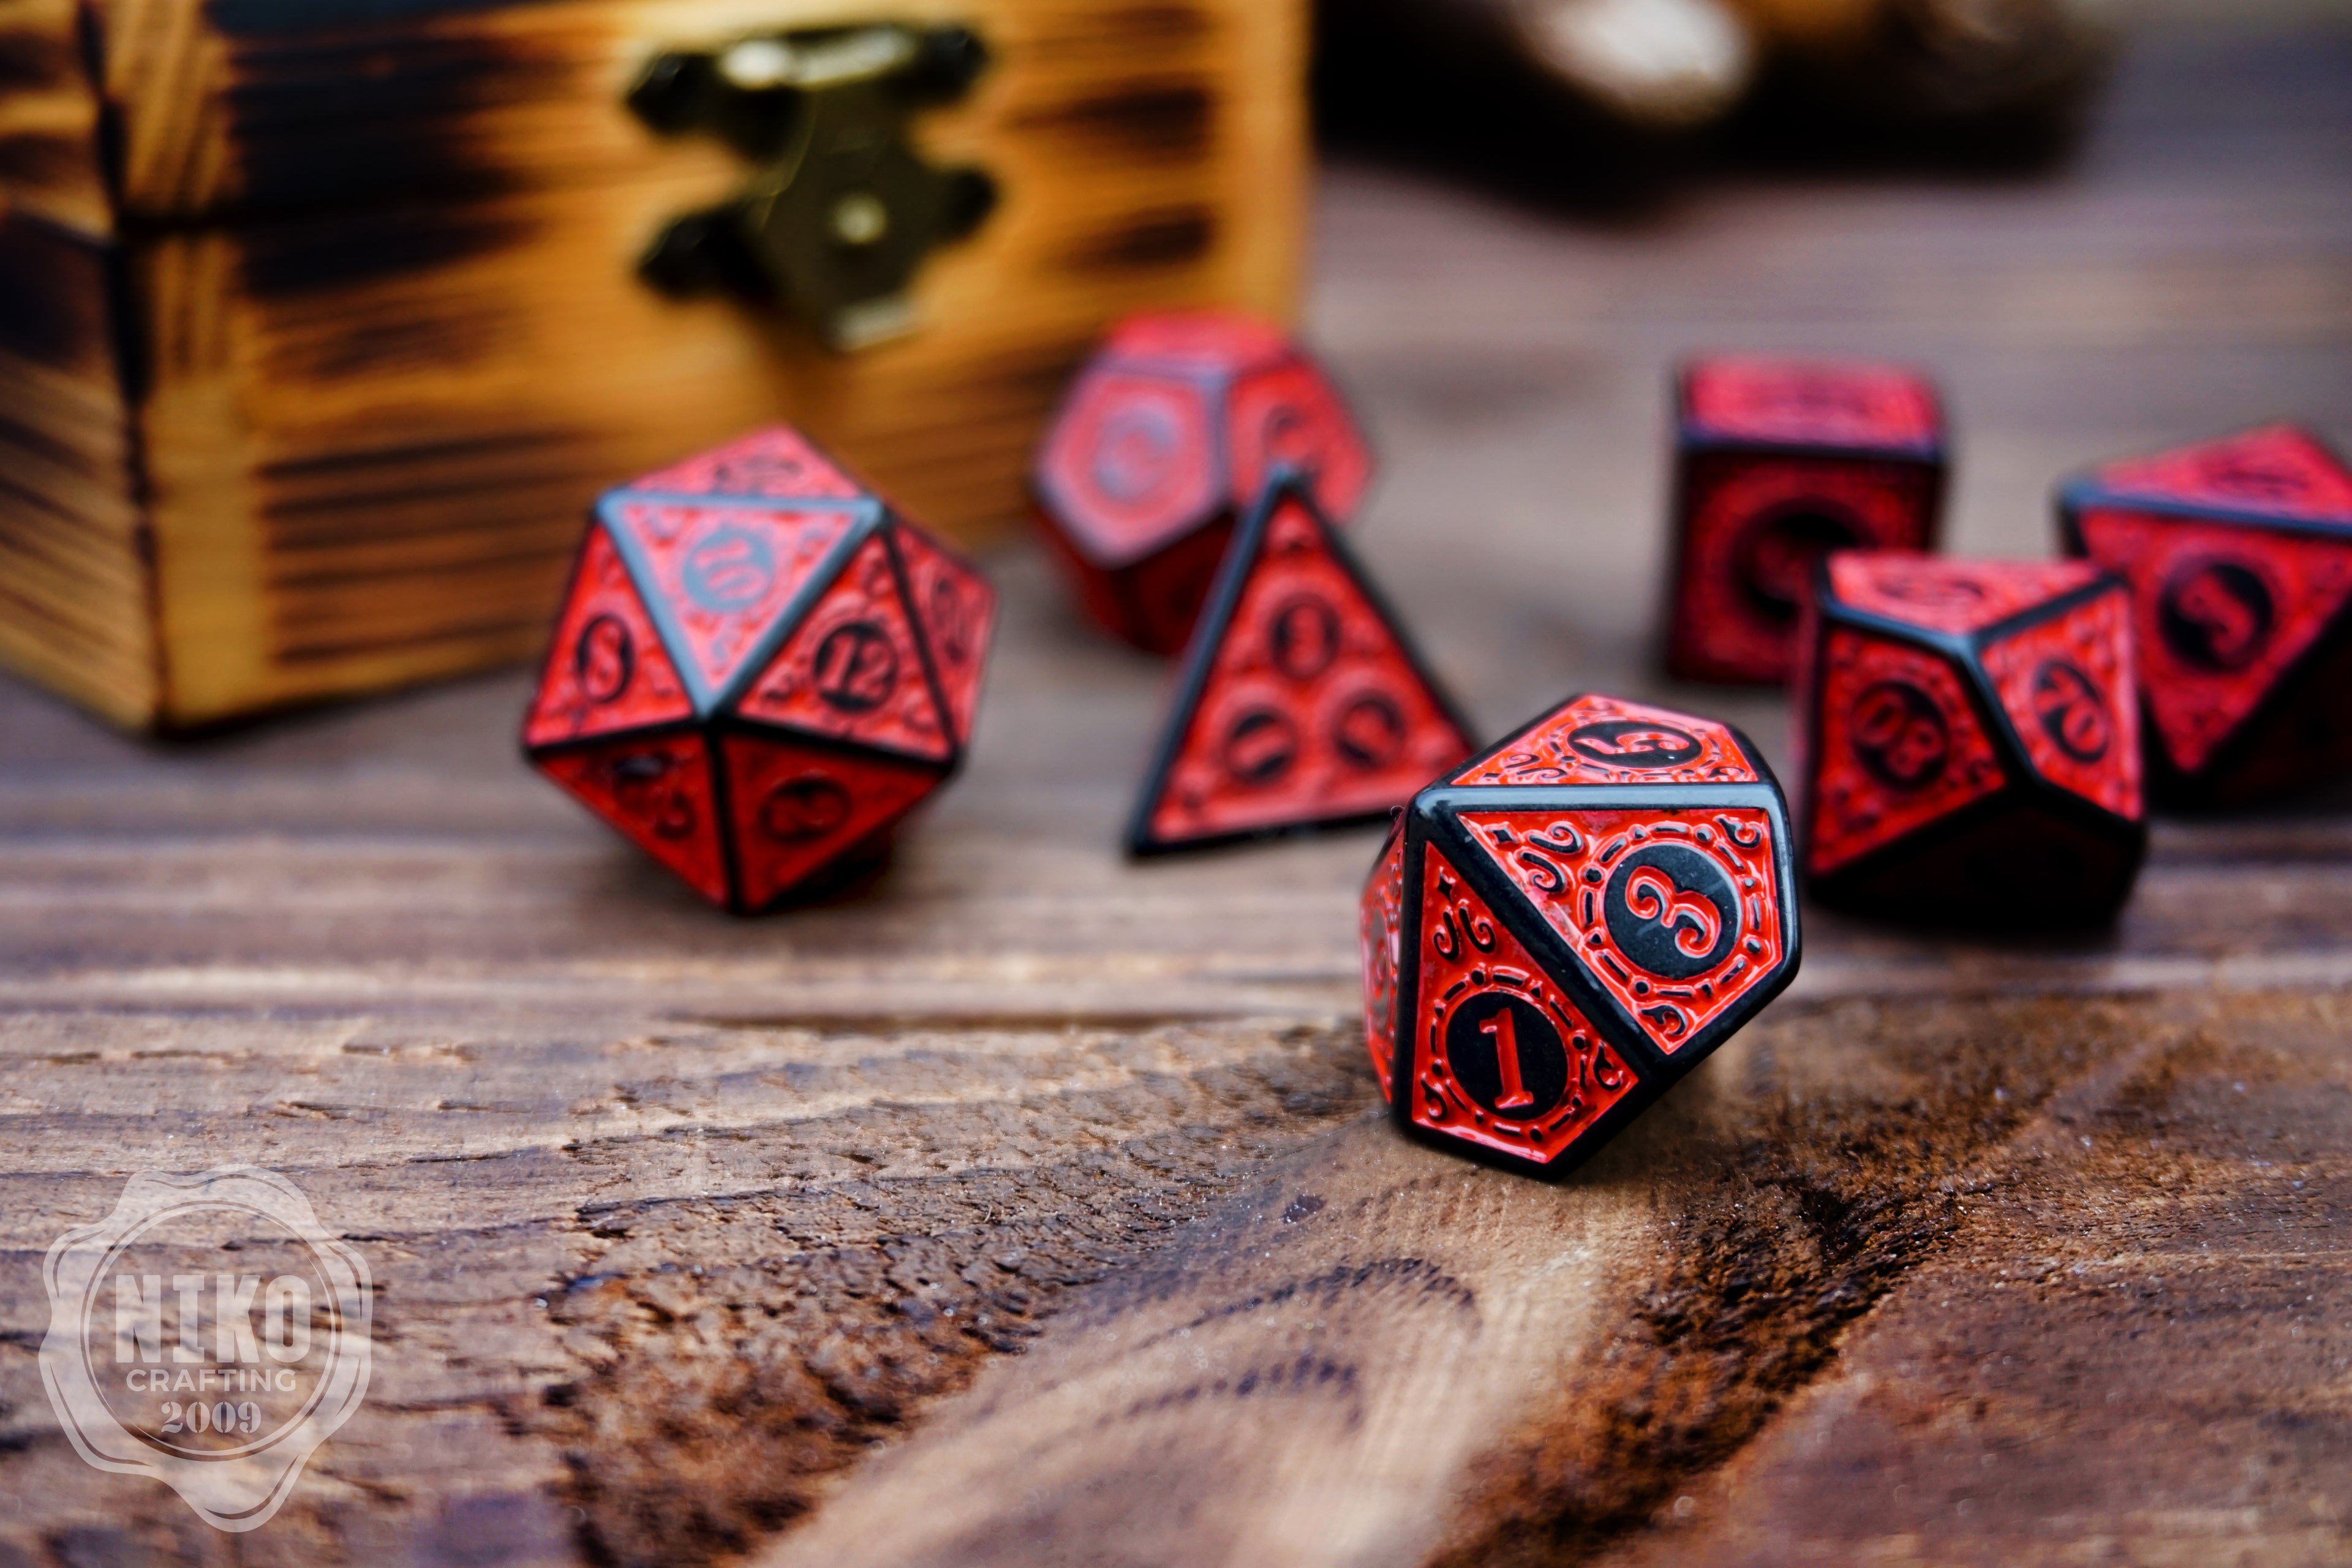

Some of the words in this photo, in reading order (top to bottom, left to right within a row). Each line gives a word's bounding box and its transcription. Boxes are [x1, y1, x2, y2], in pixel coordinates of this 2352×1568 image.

[820, 635, 890, 698] 12
[1574, 731, 1691, 756] 5
[1624, 865, 1722, 959] 3
[1479, 1007, 1534, 1110] 1
